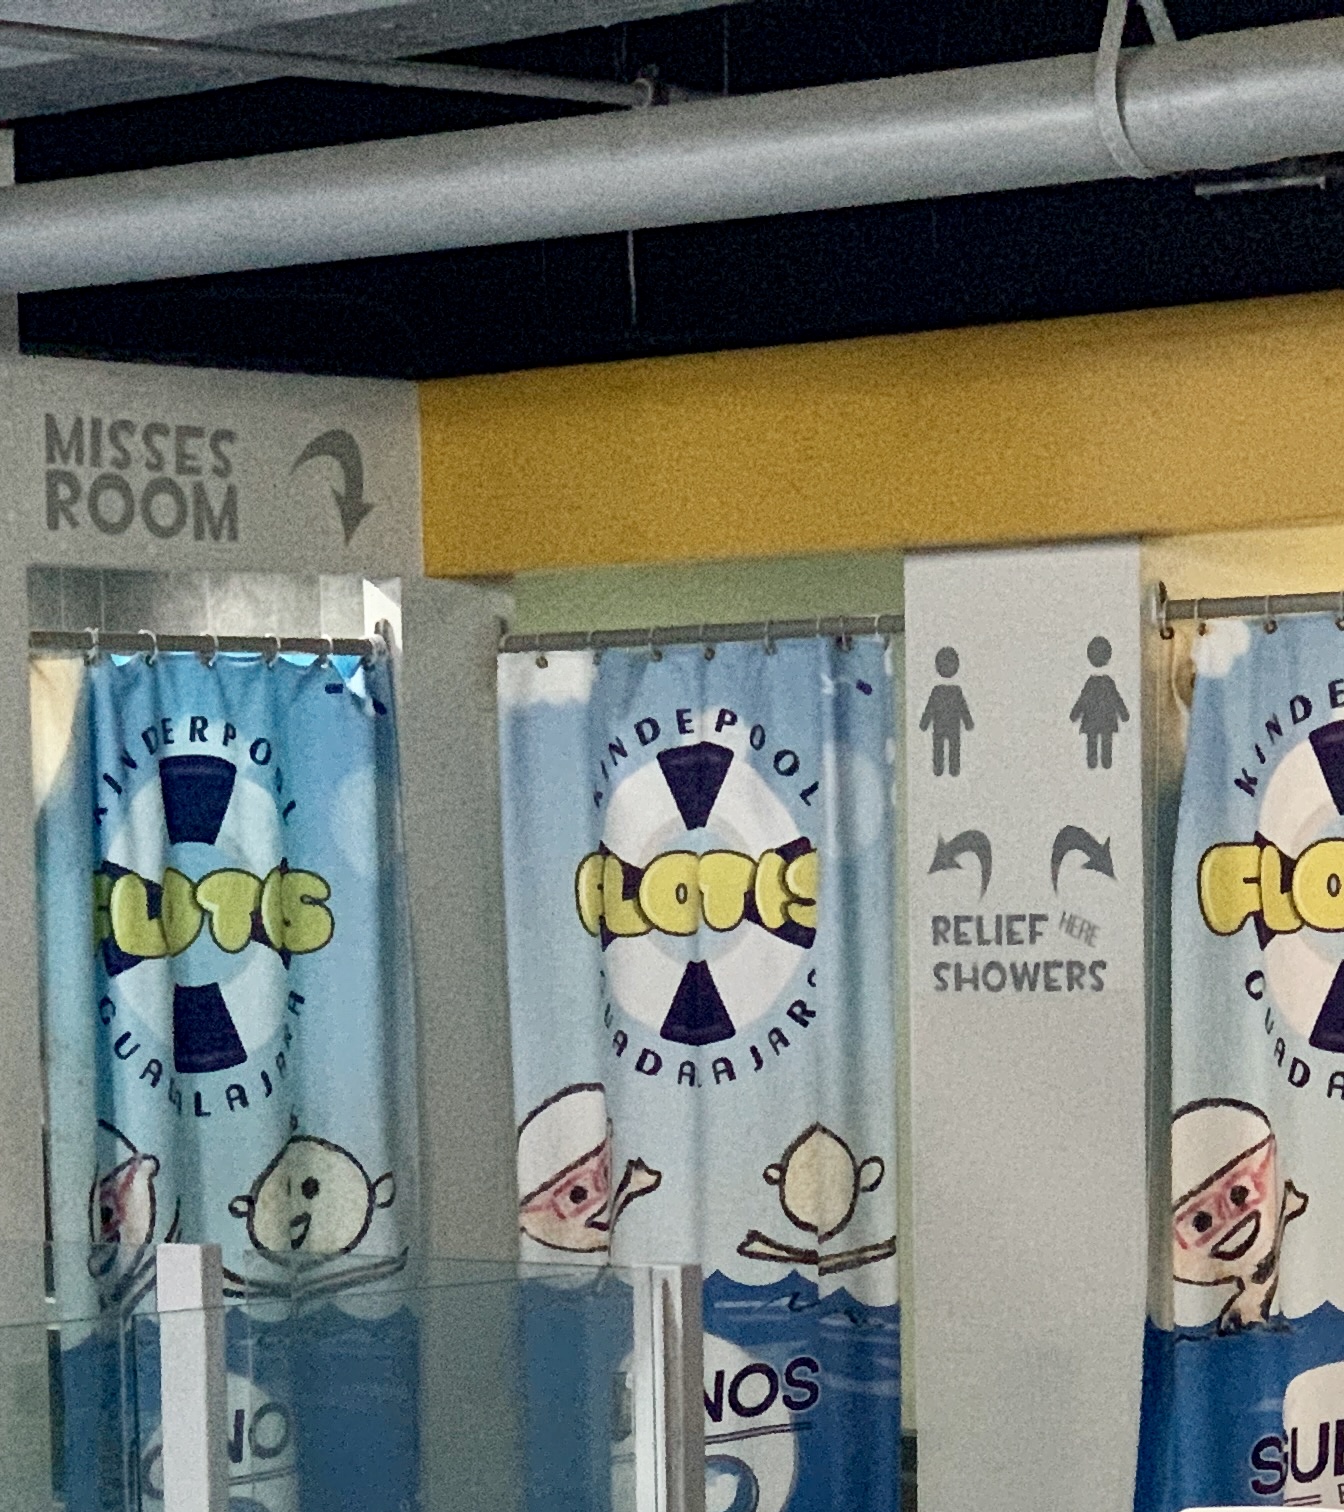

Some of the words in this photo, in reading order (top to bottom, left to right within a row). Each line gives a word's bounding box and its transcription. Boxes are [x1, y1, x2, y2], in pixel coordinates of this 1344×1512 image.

[44, 412, 238, 479] MISSES
[45, 469, 240, 543] ROOM
[931, 912, 1049, 946] RELIEF
[1059, 911, 1102, 949] HERE
[932, 959, 1108, 993] SHOWERS
